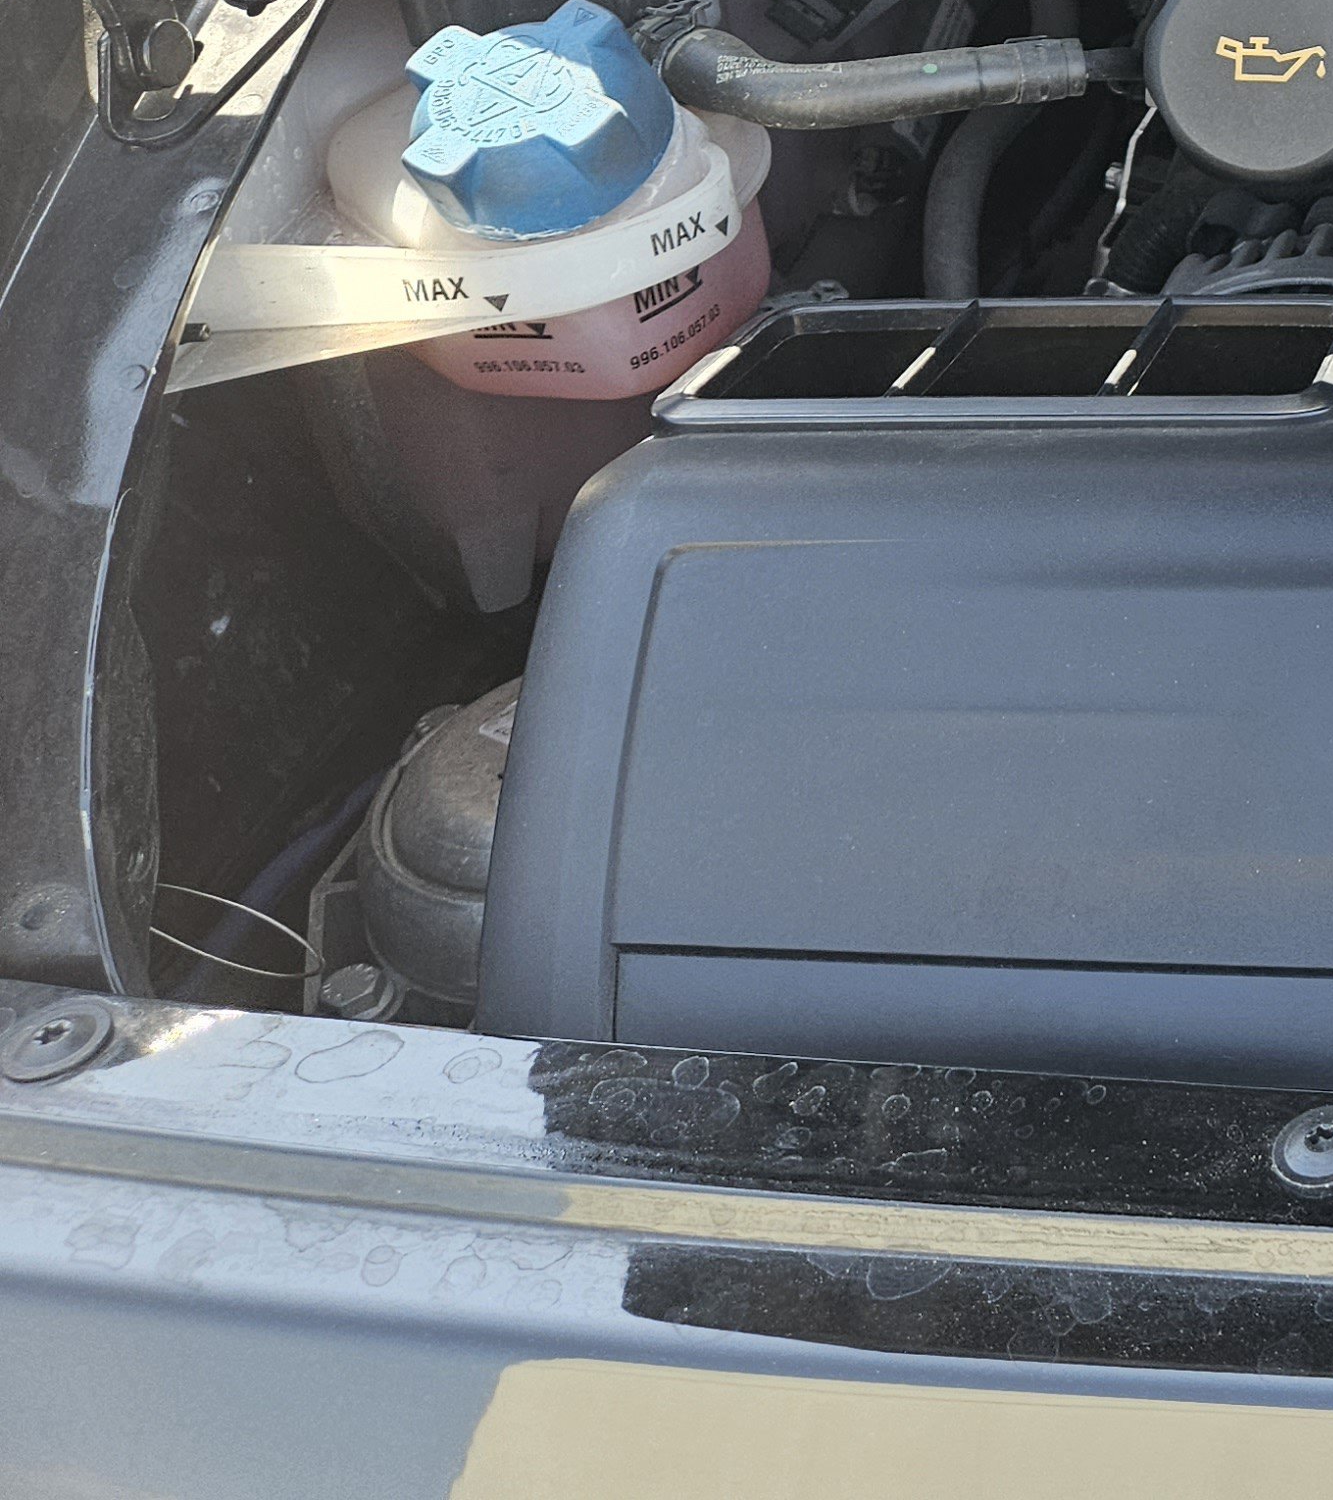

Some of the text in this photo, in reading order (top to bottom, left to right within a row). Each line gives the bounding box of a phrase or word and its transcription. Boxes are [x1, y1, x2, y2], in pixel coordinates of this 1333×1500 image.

[649, 212, 706, 256] MAX
[403, 277, 470, 303] MAX
[634, 276, 680, 314] MIN
[629, 303, 721, 369] 996.106.057.03
